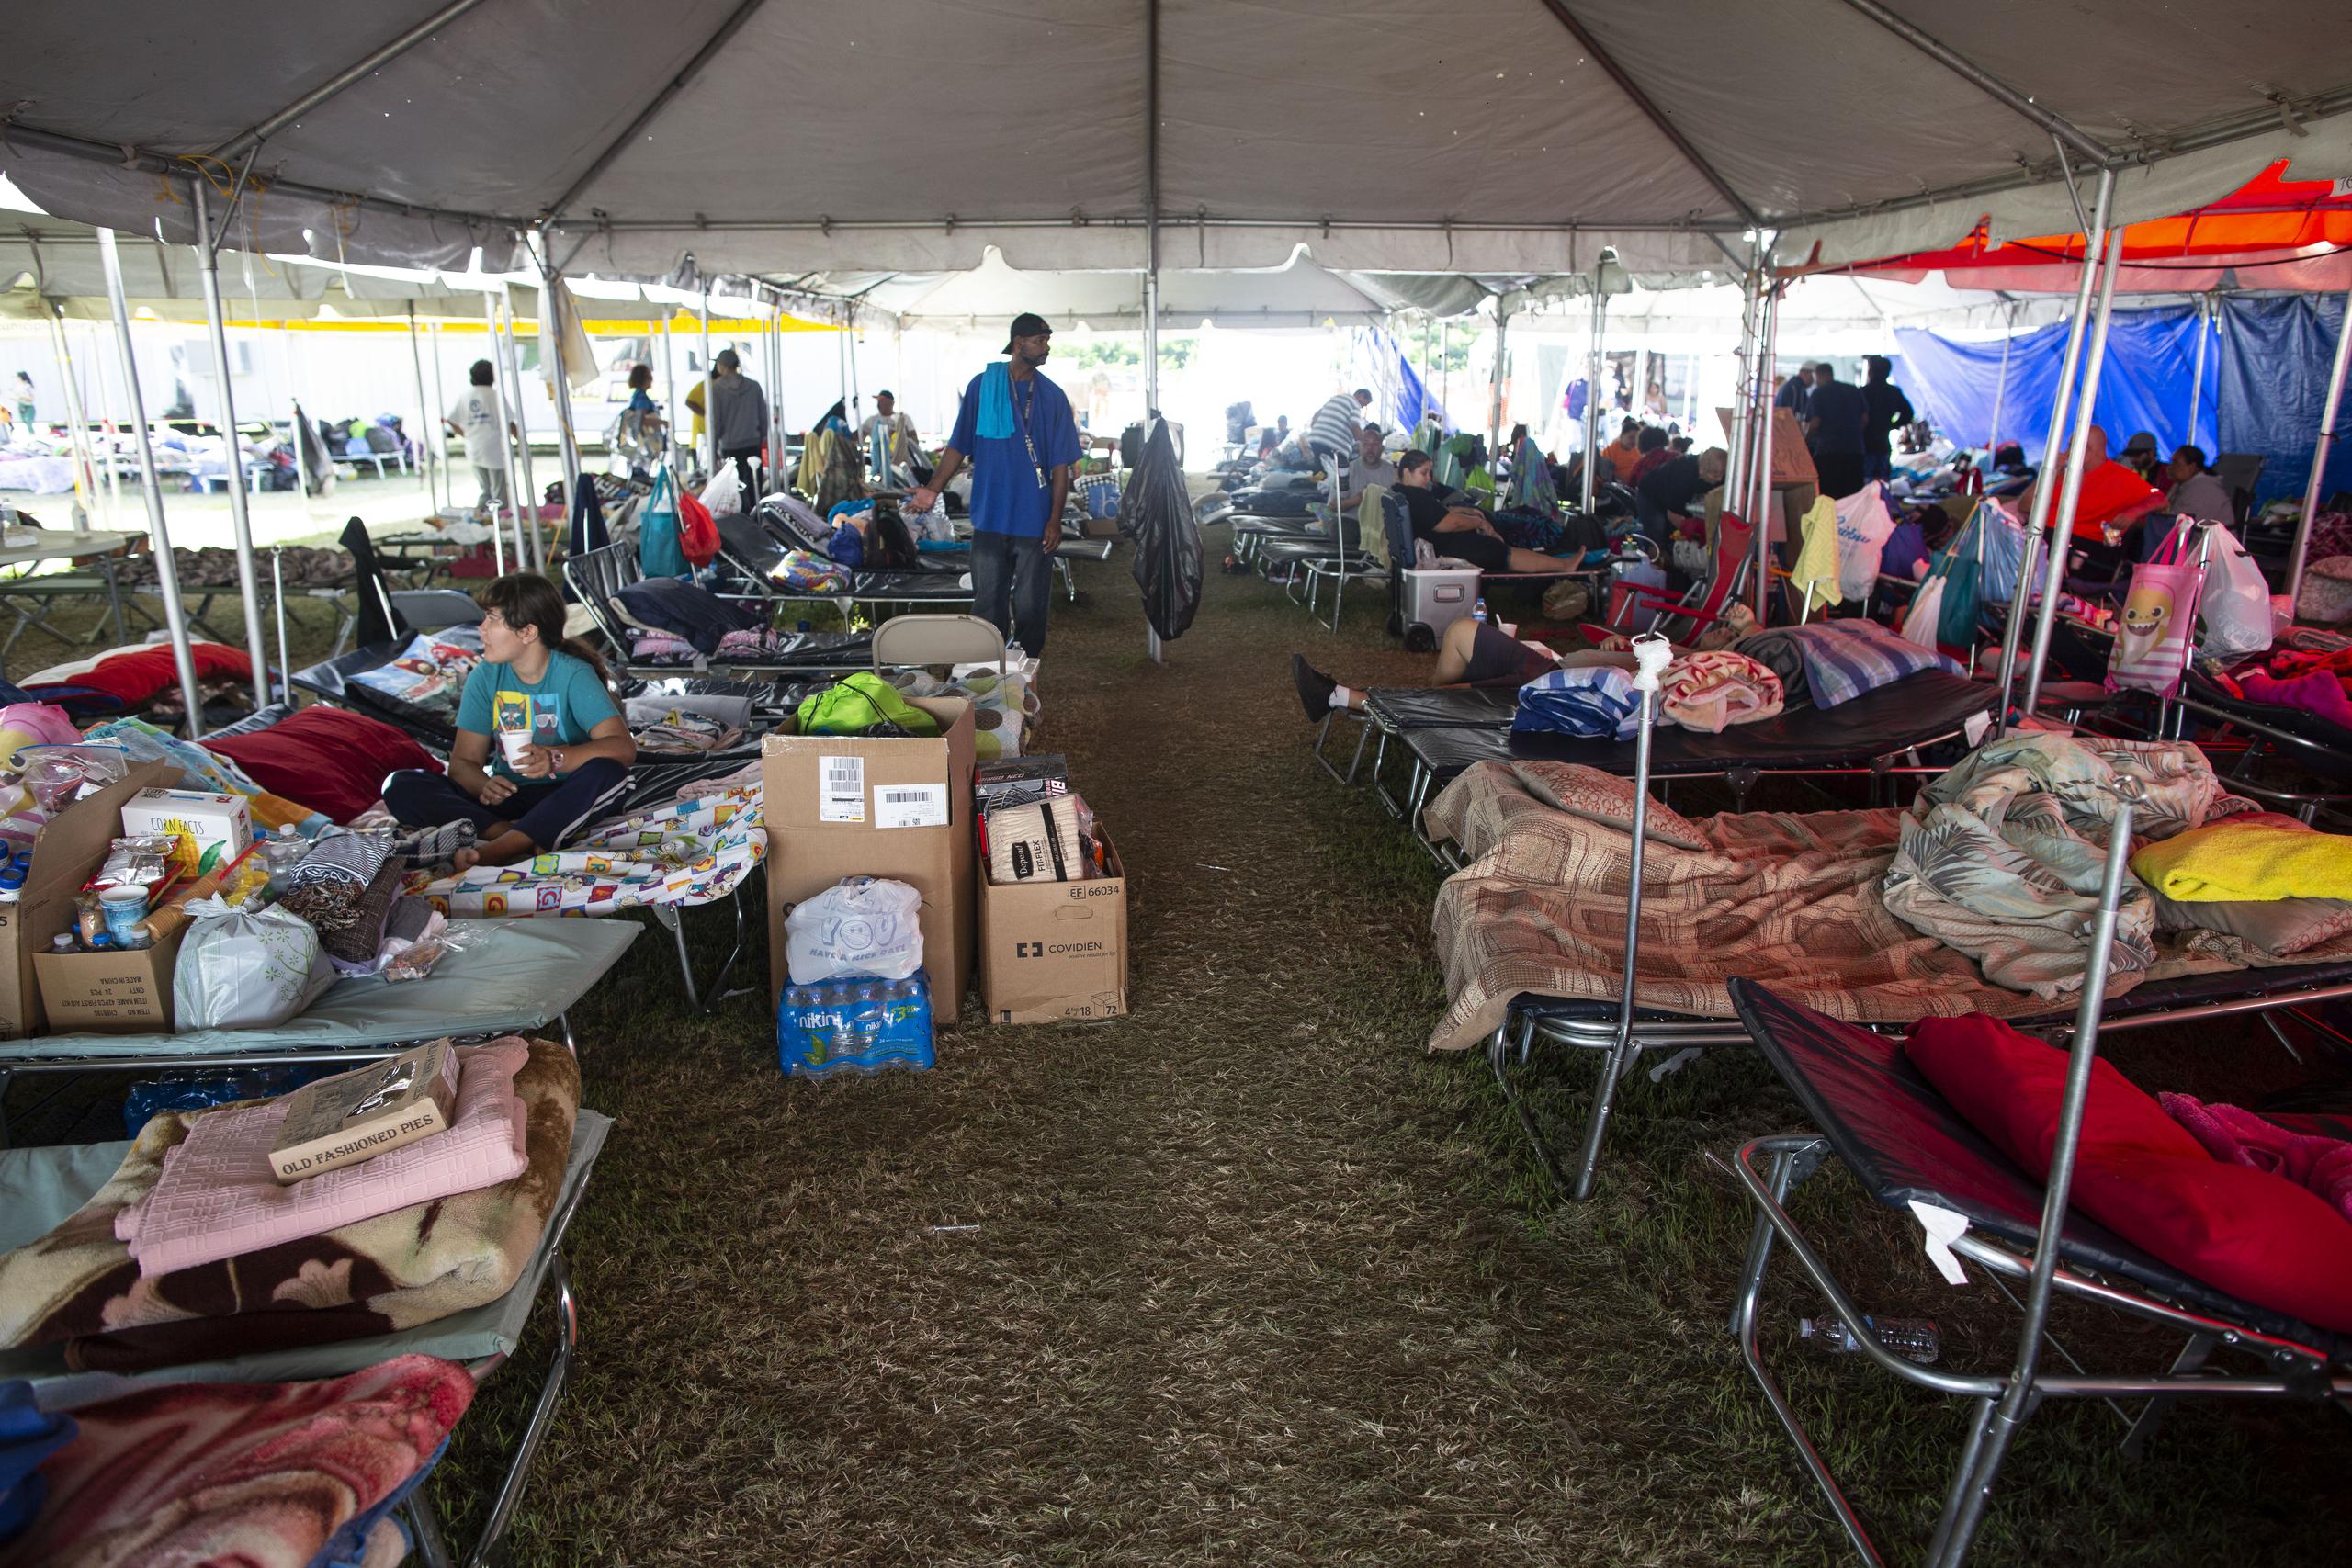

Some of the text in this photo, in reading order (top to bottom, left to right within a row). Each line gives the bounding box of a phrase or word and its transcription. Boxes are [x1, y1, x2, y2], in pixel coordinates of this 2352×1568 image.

[151, 817, 205, 835] CORN FACTS
[1014, 844, 1028, 874] Depend
[1088, 886, 1119, 897] 66034
[1048, 942, 1102, 953] COVIDIEN
[809, 948, 835, 959] HAVE
[840, 953, 848, 962] A
[852, 952, 876, 962] NICE
[1080, 1007, 1091, 1016] 18
[1106, 1005, 1118, 1015] 72
[799, 1010, 842, 1029] nikini
[282, 1114, 434, 1175] OLD FASHIONED PIES
